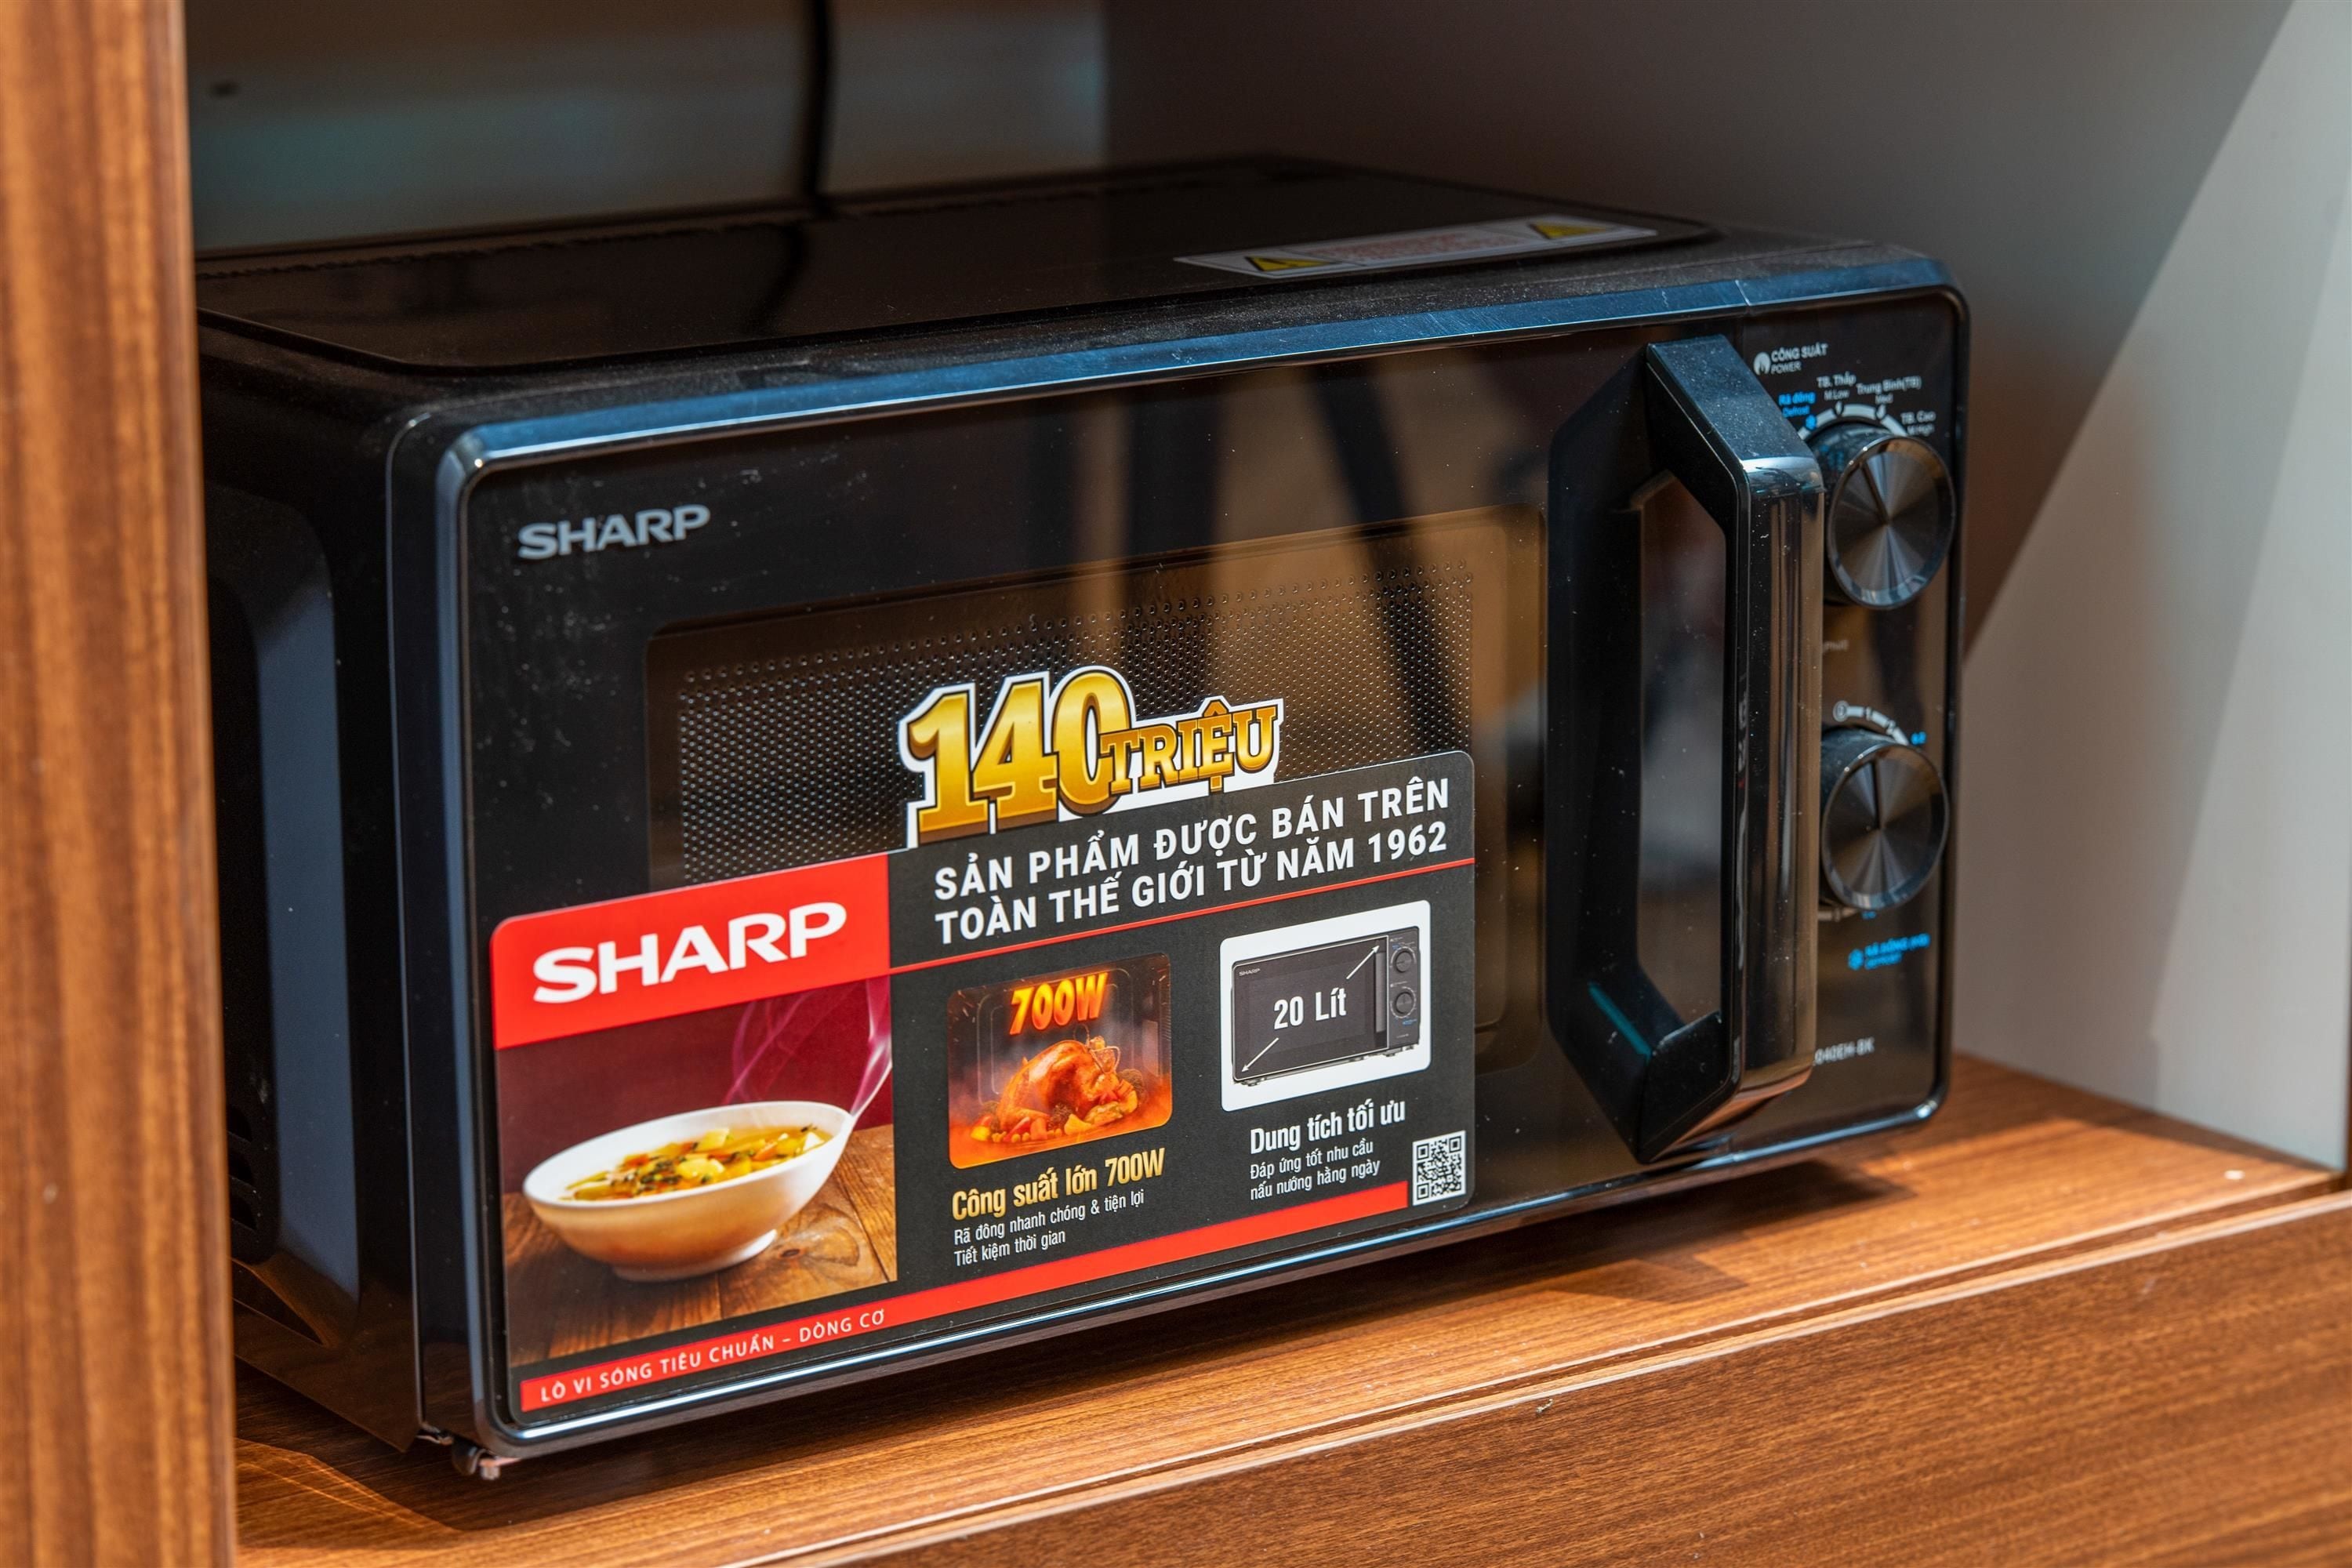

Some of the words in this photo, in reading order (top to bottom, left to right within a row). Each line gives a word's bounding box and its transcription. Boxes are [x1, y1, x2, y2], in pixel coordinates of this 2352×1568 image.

[1771, 361, 1802, 375] POWER
[518, 504, 710, 559] SHARP
[907, 669, 1134, 844] 140
[1099, 700, 1278, 793] TRIỆU
[935, 852, 1012, 900] SẢN
[1029, 829, 1138, 884] PHẨM
[1153, 813, 1257, 860] ĐƯỢC
[1272, 795, 1344, 839] BÁN
[1357, 776, 1449, 822] TRÊN
[935, 895, 1036, 944] TOÀN
[1048, 871, 1122, 923] THẾ
[1131, 860, 1204, 908] GIỚI
[1217, 850, 1268, 892] TỪ
[1276, 837, 1354, 881] NĂM
[1368, 822, 1446, 863] 1962
[532, 902, 847, 1004] SHARP
[1009, 972, 1109, 1035] 700W
[1273, 996, 1305, 1029] 20
[1315, 987, 1347, 1022] Lít
[1250, 1124, 1301, 1155] Dung
[1307, 1112, 1343, 1142] tích
[1348, 1098, 1374, 1132] tối
[1380, 1100, 1406, 1126] ưu
[952, 1188, 1007, 1221] Công
[1013, 1167, 1058, 1207] suất
[1065, 1164, 1098, 1196] lớn
[1105, 1148, 1166, 1187] 700W
[1250, 1161, 1276, 1180] Đáp
[1279, 1157, 1301, 1174] ứng
[1305, 1149, 1323, 1167] tốt
[1327, 1145, 1348, 1163] nhu
[1352, 1138, 1374, 1156] cầu
[1250, 1179, 1272, 1200] nấu
[1276, 1175, 1312, 1195] nướng
[1317, 1166, 1347, 1186] hằng
[1351, 1160, 1381, 1180] ngày
[954, 1229, 971, 1246] Rã
[975, 1222, 1005, 1241] đông
[1010, 1212, 1046, 1233] nhanh
[1050, 1204, 1086, 1223] chóng
[1091, 1200, 1100, 1214] &
[1104, 1195, 1127, 1213] tiện
[1131, 1189, 1145, 1207] lợi
[954, 1245, 978, 1267] Tiết
[982, 1242, 1010, 1262] kiệm
[1014, 1234, 1037, 1253] thời
[1041, 1230, 1066, 1250] gian
[541, 1380, 566, 1403] LÒ
[573, 1376, 592, 1394] VI
[600, 1363, 652, 1388] SÓNG
[659, 1352, 702, 1374] TIÊU
[709, 1334, 775, 1363] CHUẨN
[798, 1317, 852, 1343] DÒNG
[859, 1308, 885, 1328] CƠ
